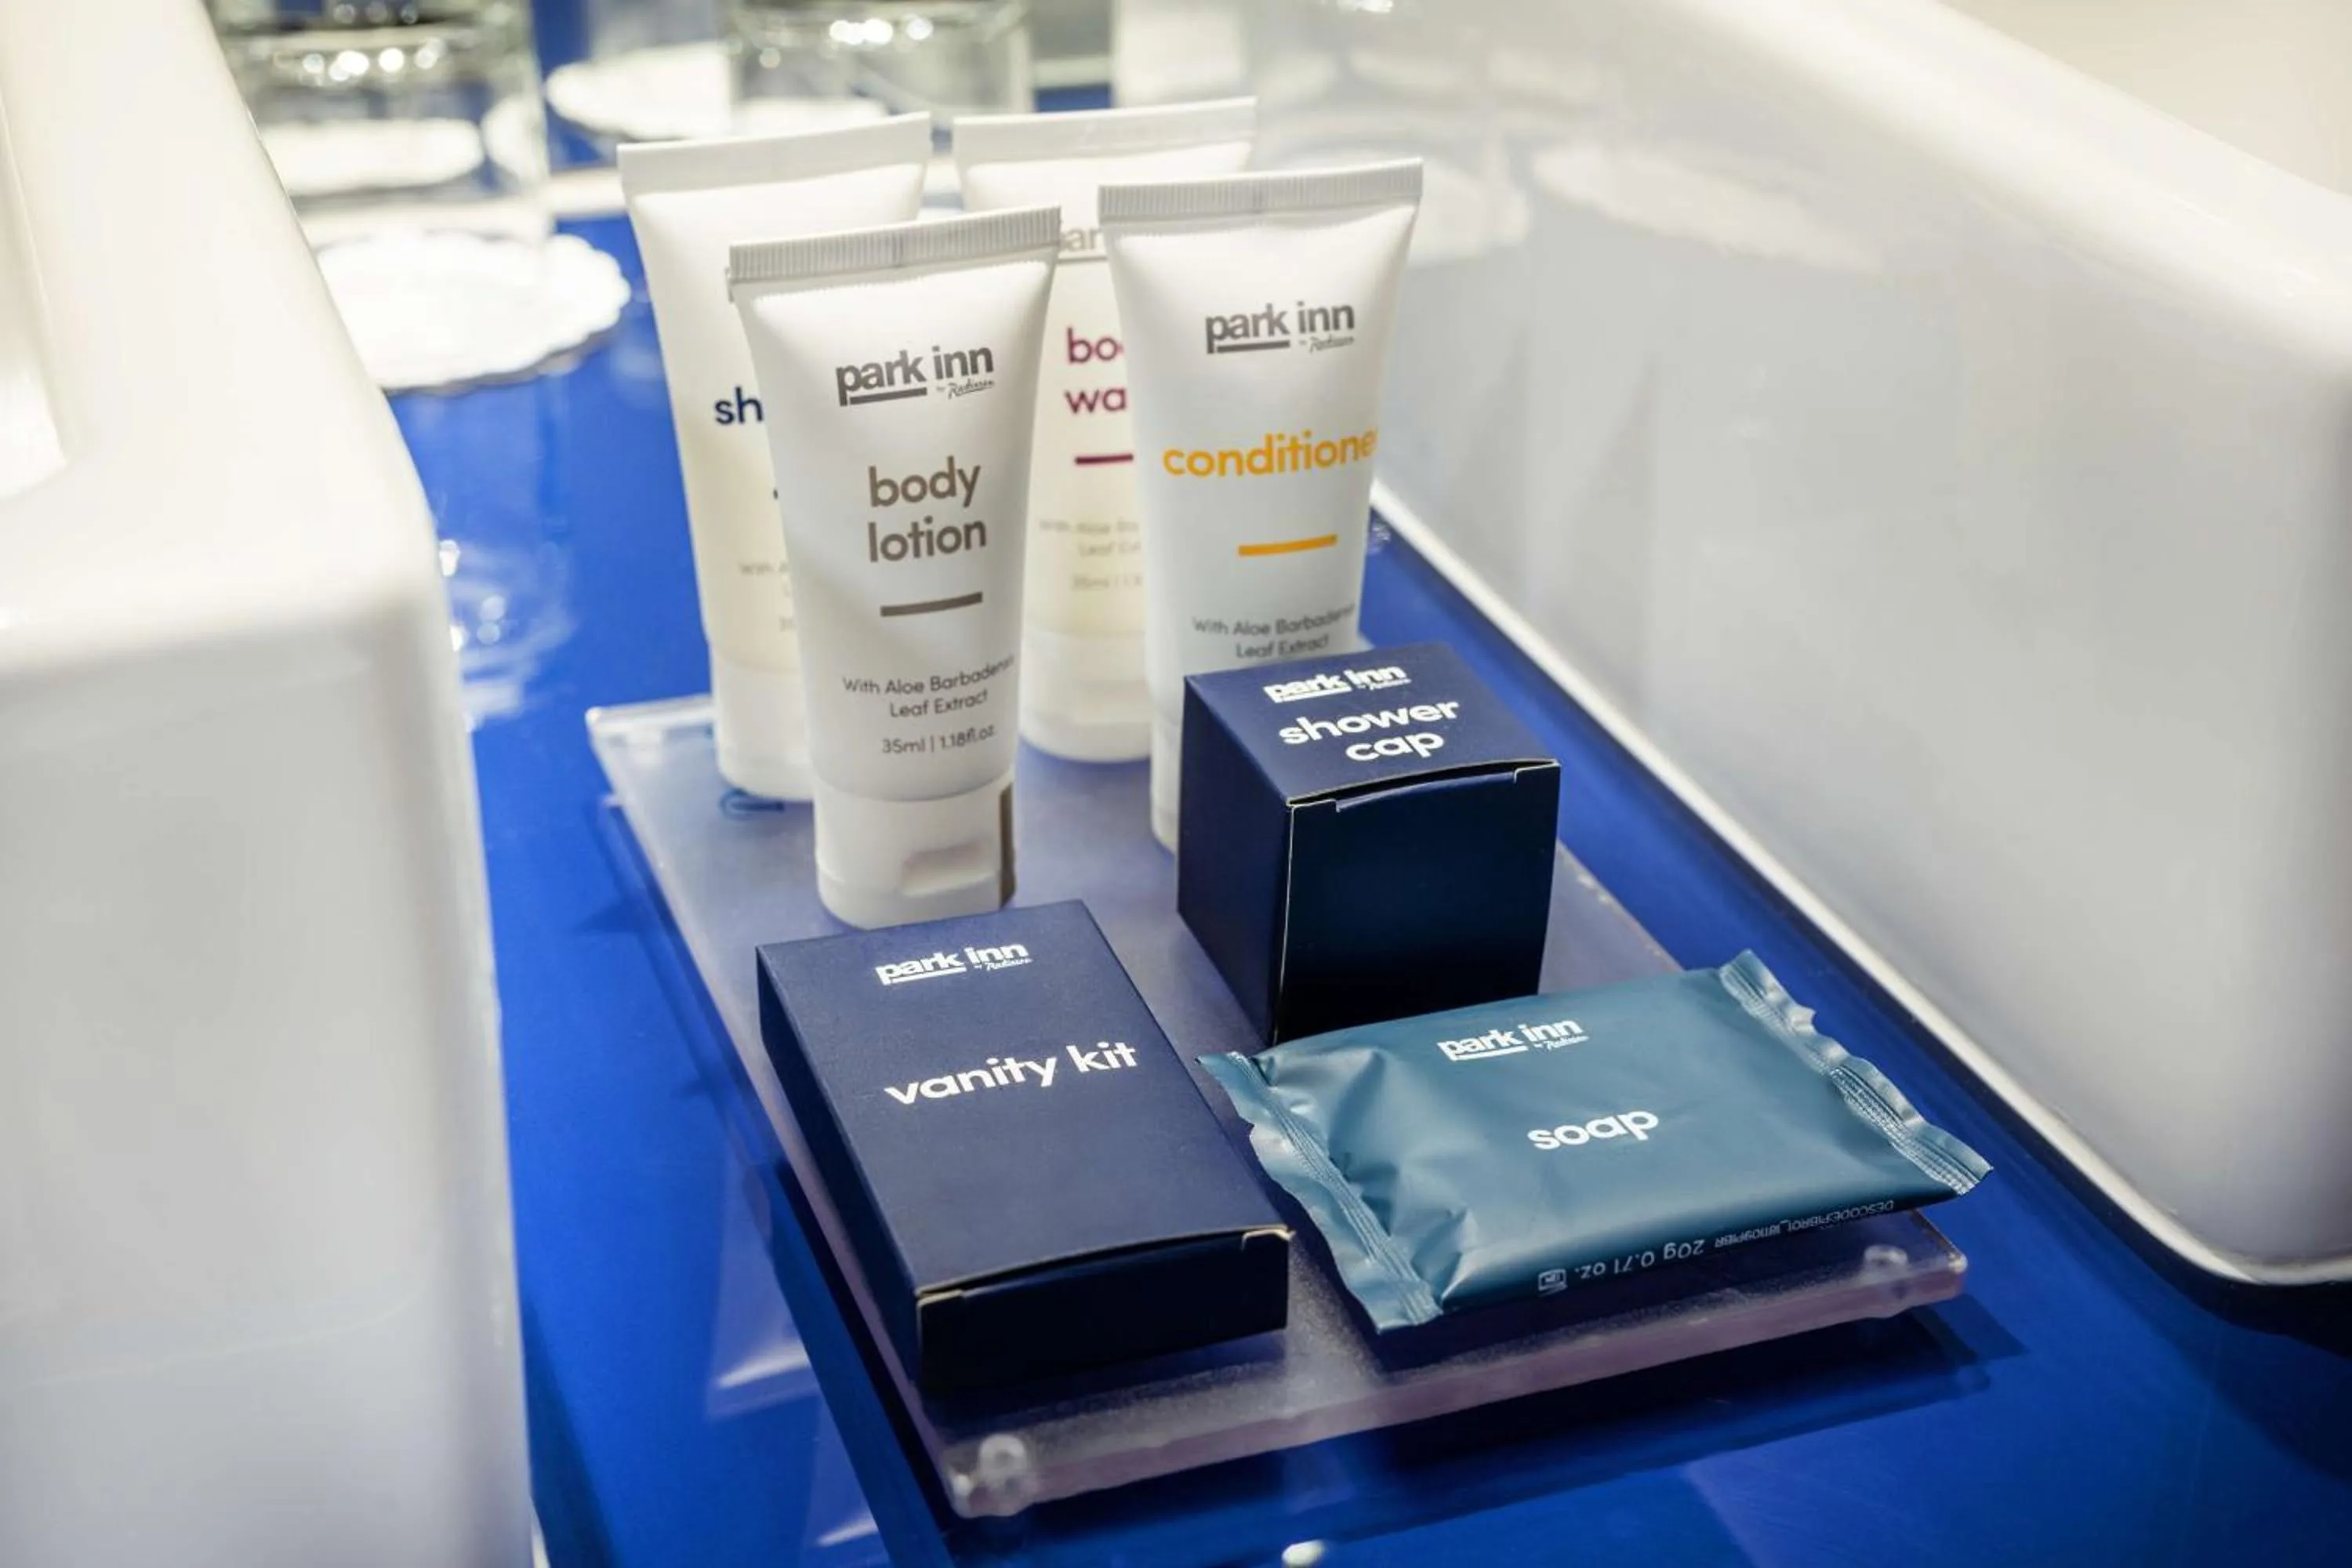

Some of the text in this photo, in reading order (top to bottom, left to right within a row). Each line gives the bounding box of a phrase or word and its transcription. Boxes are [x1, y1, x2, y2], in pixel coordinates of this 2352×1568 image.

[1059, 227, 1100, 252] ar
[1066, 326, 1123, 365] bo
[1206, 303, 1290, 355] park
[1297, 301, 1355, 334] inn
[836, 345, 994, 407] park inn
[714, 386, 764, 425] sh
[1064, 387, 1127, 415] wa
[1163, 427, 1378, 478] conditione
[868, 456, 981, 508] body
[868, 516, 987, 563] lotion
[1192, 616, 1229, 635] With
[1232, 619, 1271, 636] Aloe
[1235, 633, 1330, 659] Leaf Extract
[842, 677, 880, 695] With
[884, 678, 925, 695] Aloe
[890, 689, 988, 718] Leaf Extract
[1263, 673, 1352, 703] park
[1343, 666, 1407, 686] inn
[1279, 701, 1459, 745] shower
[882, 738, 926, 754] 35ml
[1345, 731, 1445, 761] cap
[875, 943, 1029, 985] park inn
[1436, 1029, 1529, 1062] park
[1517, 1019, 1584, 1043] inn
[884, 1041, 1139, 1105] vanity kit
[1527, 1110, 1660, 1150] soap
[1613, 1250, 1656, 1275] 0.71
[1663, 1239, 1705, 1260] 20g
[1574, 1261, 1606, 1279] oz.
